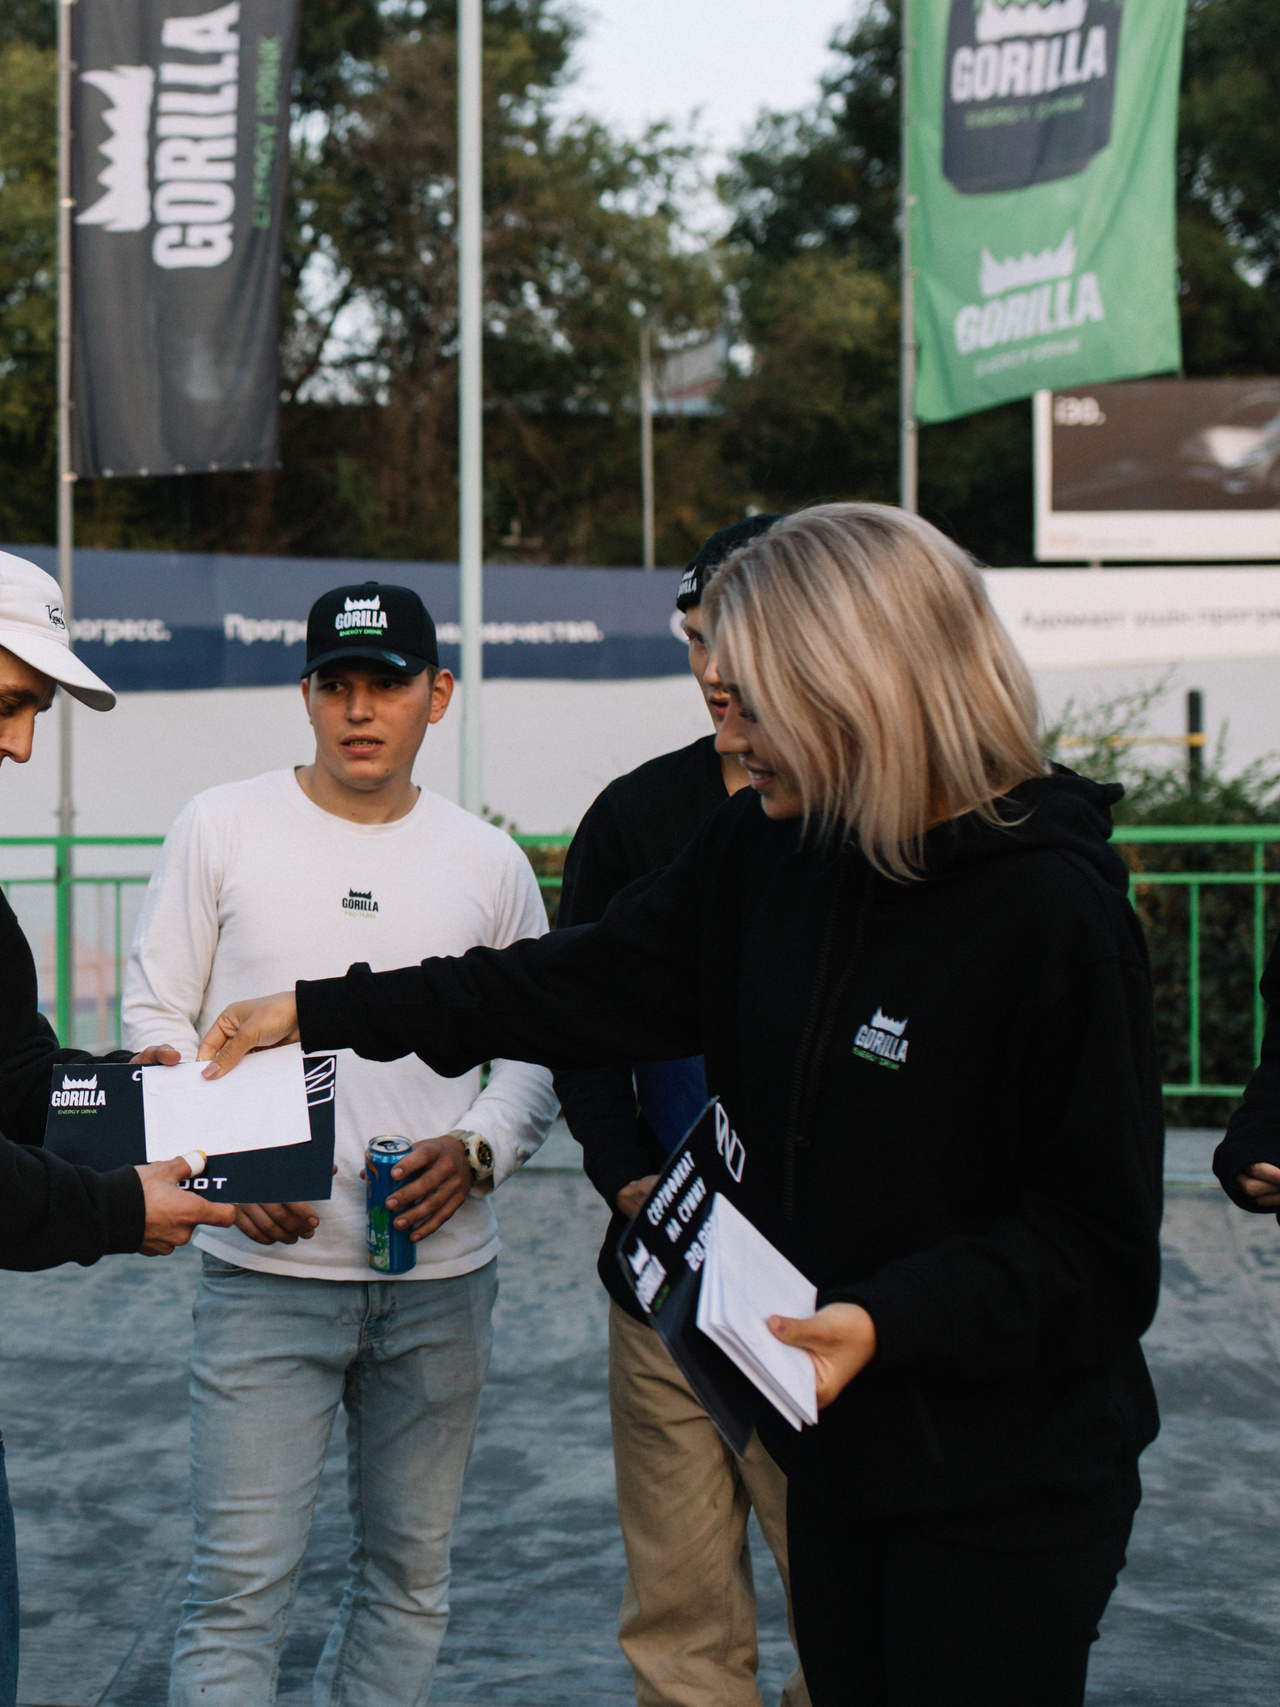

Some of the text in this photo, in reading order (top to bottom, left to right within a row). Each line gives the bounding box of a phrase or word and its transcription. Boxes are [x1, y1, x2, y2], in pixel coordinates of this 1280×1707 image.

[951, 25, 1108, 103] GORILLA
[152, 1, 240, 268] GORILLA
[955, 272, 1105, 355] GORILLA
[70, 617, 172, 647] огресс.
[335, 610, 388, 630] GORILLA
[339, 628, 382, 637] ENERGY DRINK
[341, 898, 379, 912] GORILLA
[854, 1024, 909, 1063] GORILLA
[51, 1090, 106, 1107] GORILLA
[646, 1150, 696, 1226] СЕРТИФИКАТ
[665, 1176, 707, 1243] НА СУММУ
